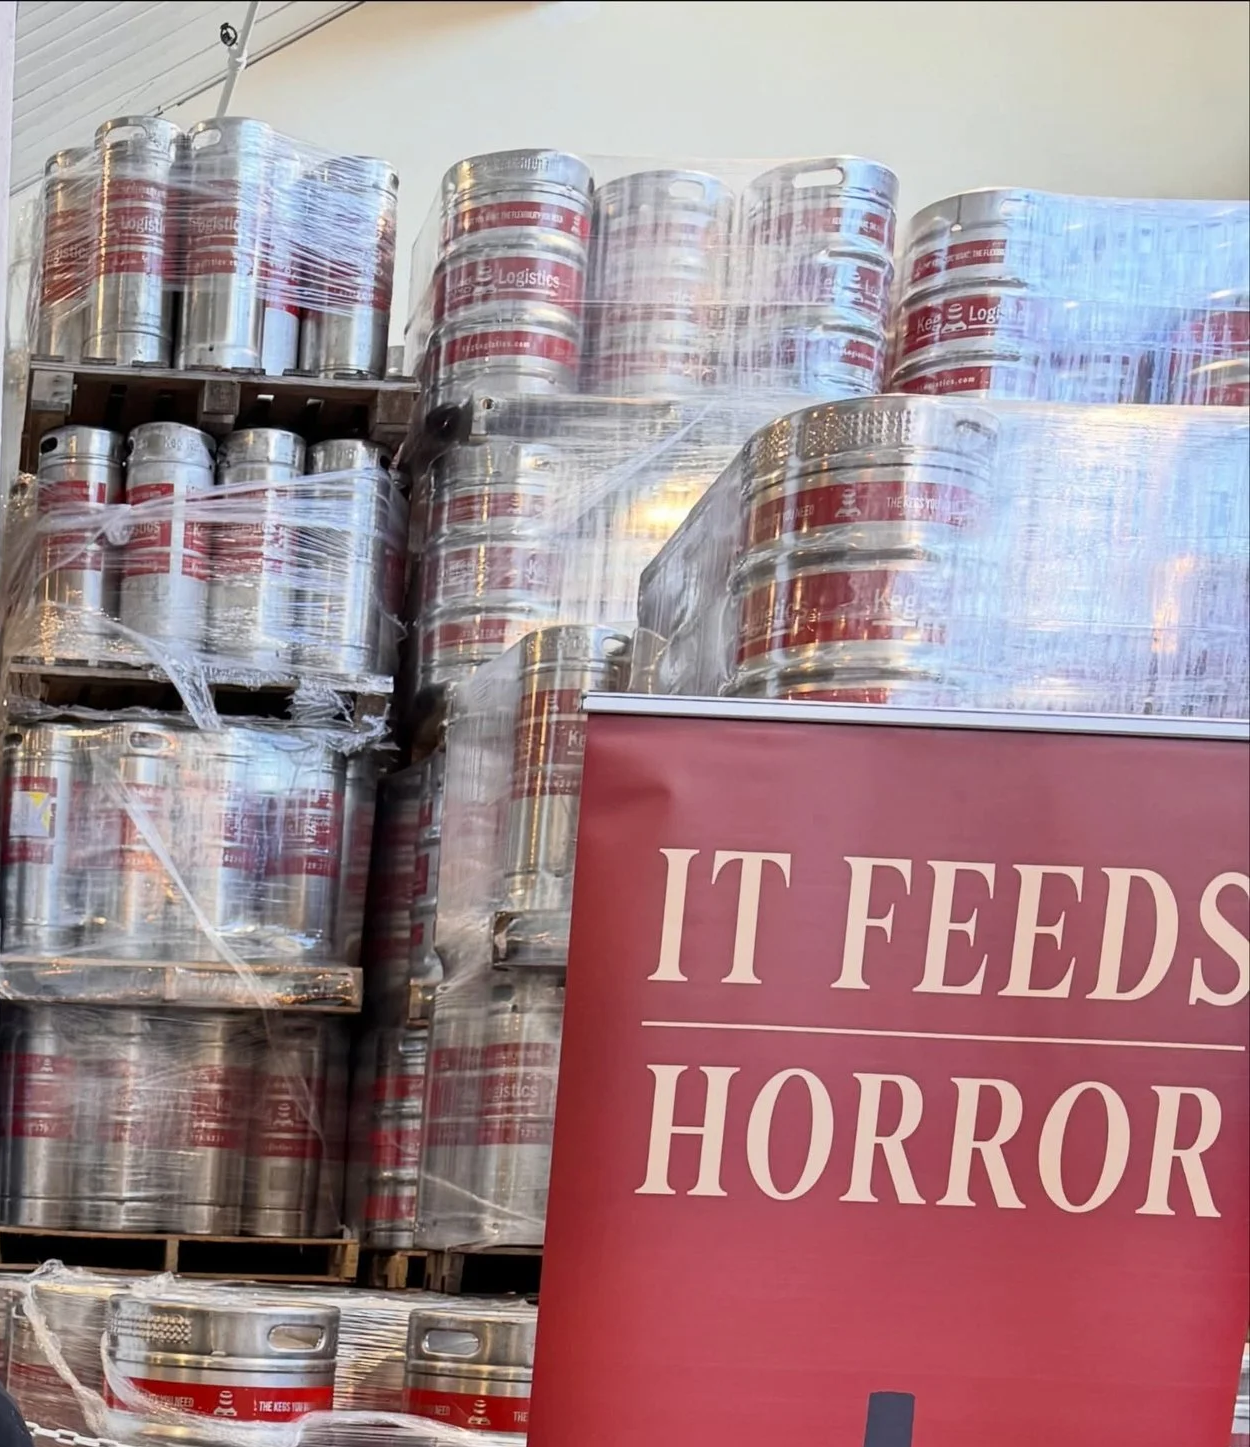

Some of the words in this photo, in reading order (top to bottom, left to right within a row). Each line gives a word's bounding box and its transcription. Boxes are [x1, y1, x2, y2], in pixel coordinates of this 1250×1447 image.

[497, 267, 560, 289] Logistics
[916, 313, 942, 334] Keg
[647, 847, 792, 985] IT
[830, 855, 1250, 1008] FEEDS
[634, 1063, 1224, 1219] HORROR
[259, 1400, 272, 1412] THE
